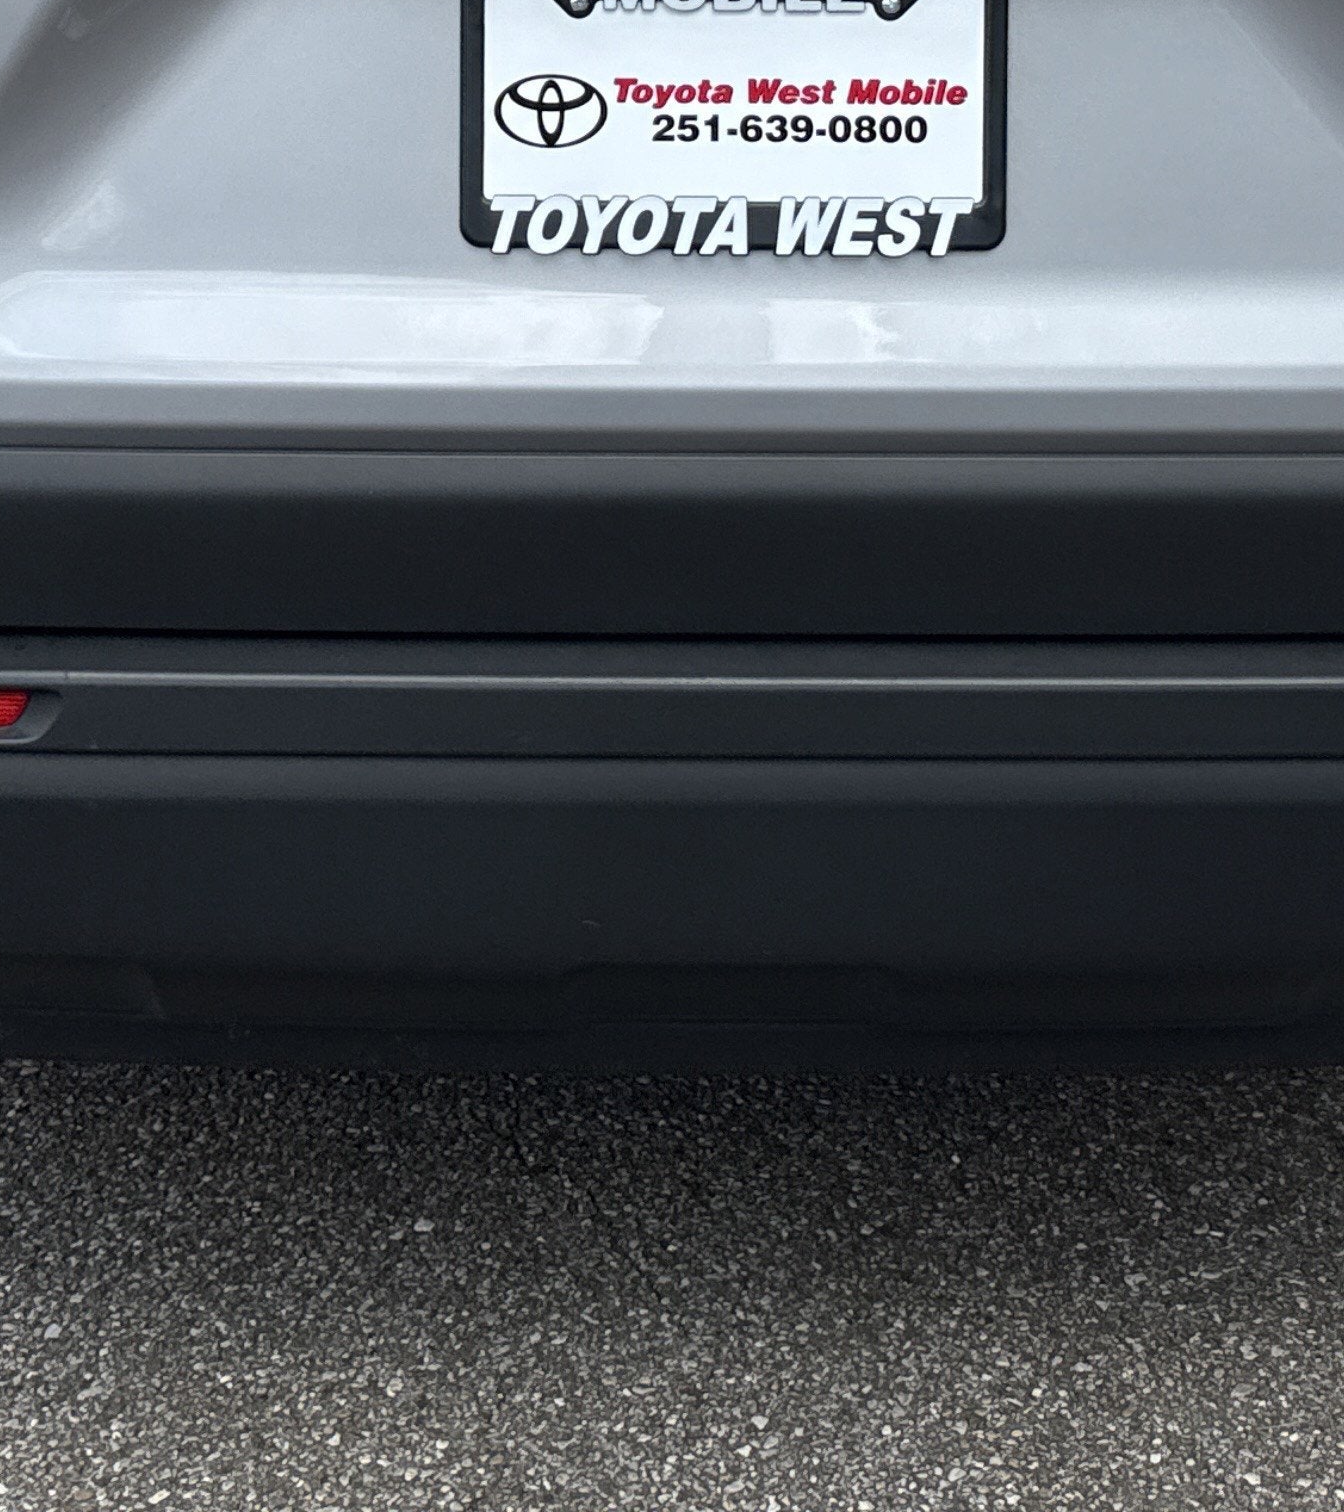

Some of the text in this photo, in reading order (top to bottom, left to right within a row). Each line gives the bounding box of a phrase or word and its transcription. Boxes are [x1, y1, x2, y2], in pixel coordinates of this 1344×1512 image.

[614, 78, 969, 111] Toyota West Mobile
[651, 115, 928, 144] 251-639-0800
[485, 195, 976, 257] TOYOTA WEST
